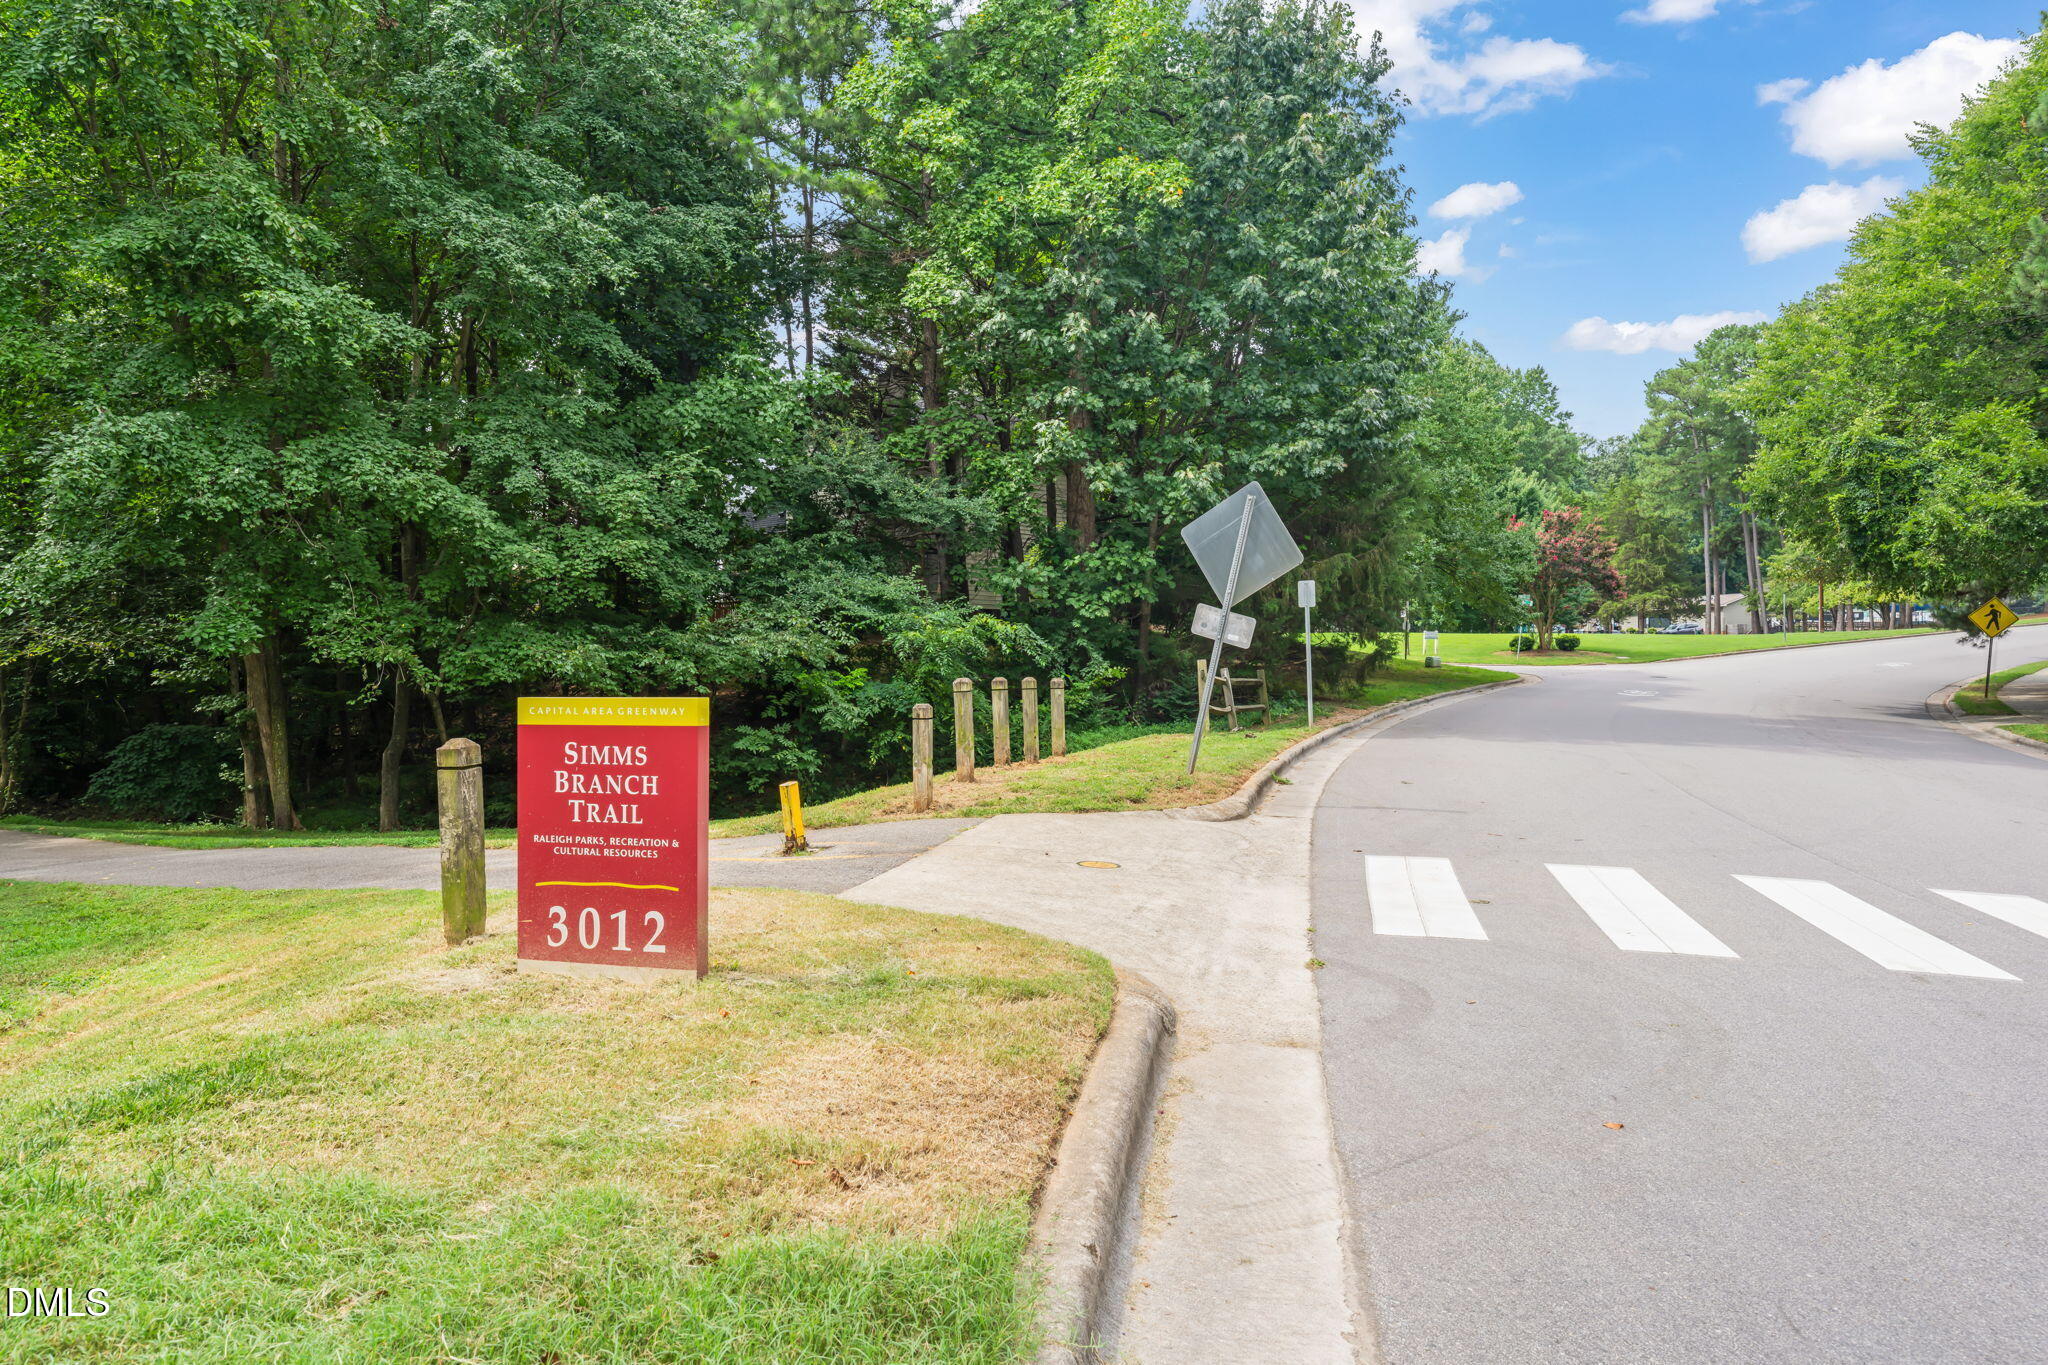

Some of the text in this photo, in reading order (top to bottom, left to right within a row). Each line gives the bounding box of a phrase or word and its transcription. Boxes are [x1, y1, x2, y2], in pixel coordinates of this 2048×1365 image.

[529, 706, 685, 716] CAPITAL AREA GREENWAY
[564, 741, 648, 766] SIMMS
[553, 770, 659, 795] BRANCH
[568, 800, 643, 825] TRAIL
[533, 834, 680, 848] RALEIGH PARKS, RECREATION &
[553, 846, 658, 858] CULTURAL RESOURCES
[547, 905, 666, 953] 3012
